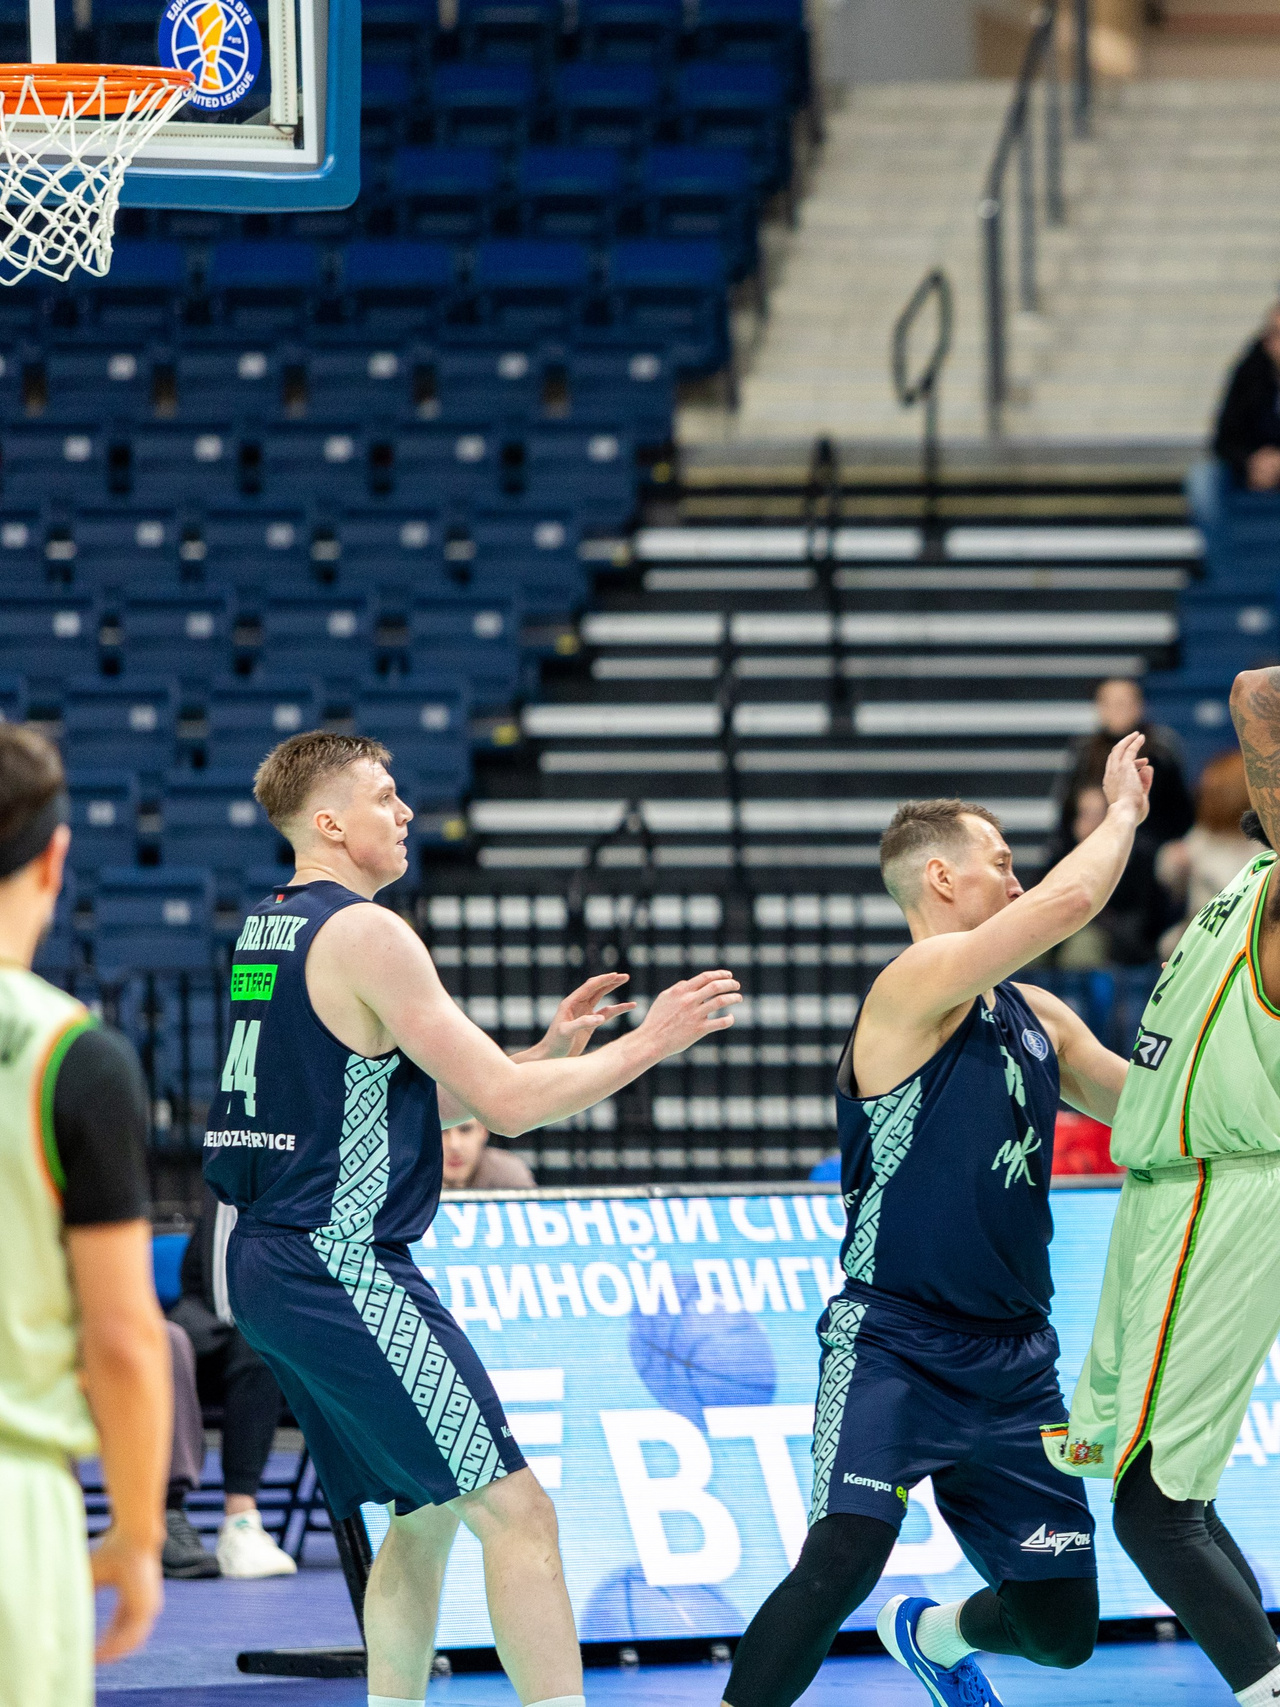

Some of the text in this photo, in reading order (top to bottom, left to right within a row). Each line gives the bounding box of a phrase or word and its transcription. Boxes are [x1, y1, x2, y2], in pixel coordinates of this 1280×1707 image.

[235, 1, 253, 25] ВТБ
[183, 71, 254, 108] UNITED LEAGUE
[221, 1020, 261, 1117] 44
[422, 1247, 682, 1331] ДИНОЙ
[843, 1472, 892, 1492] Kempa
